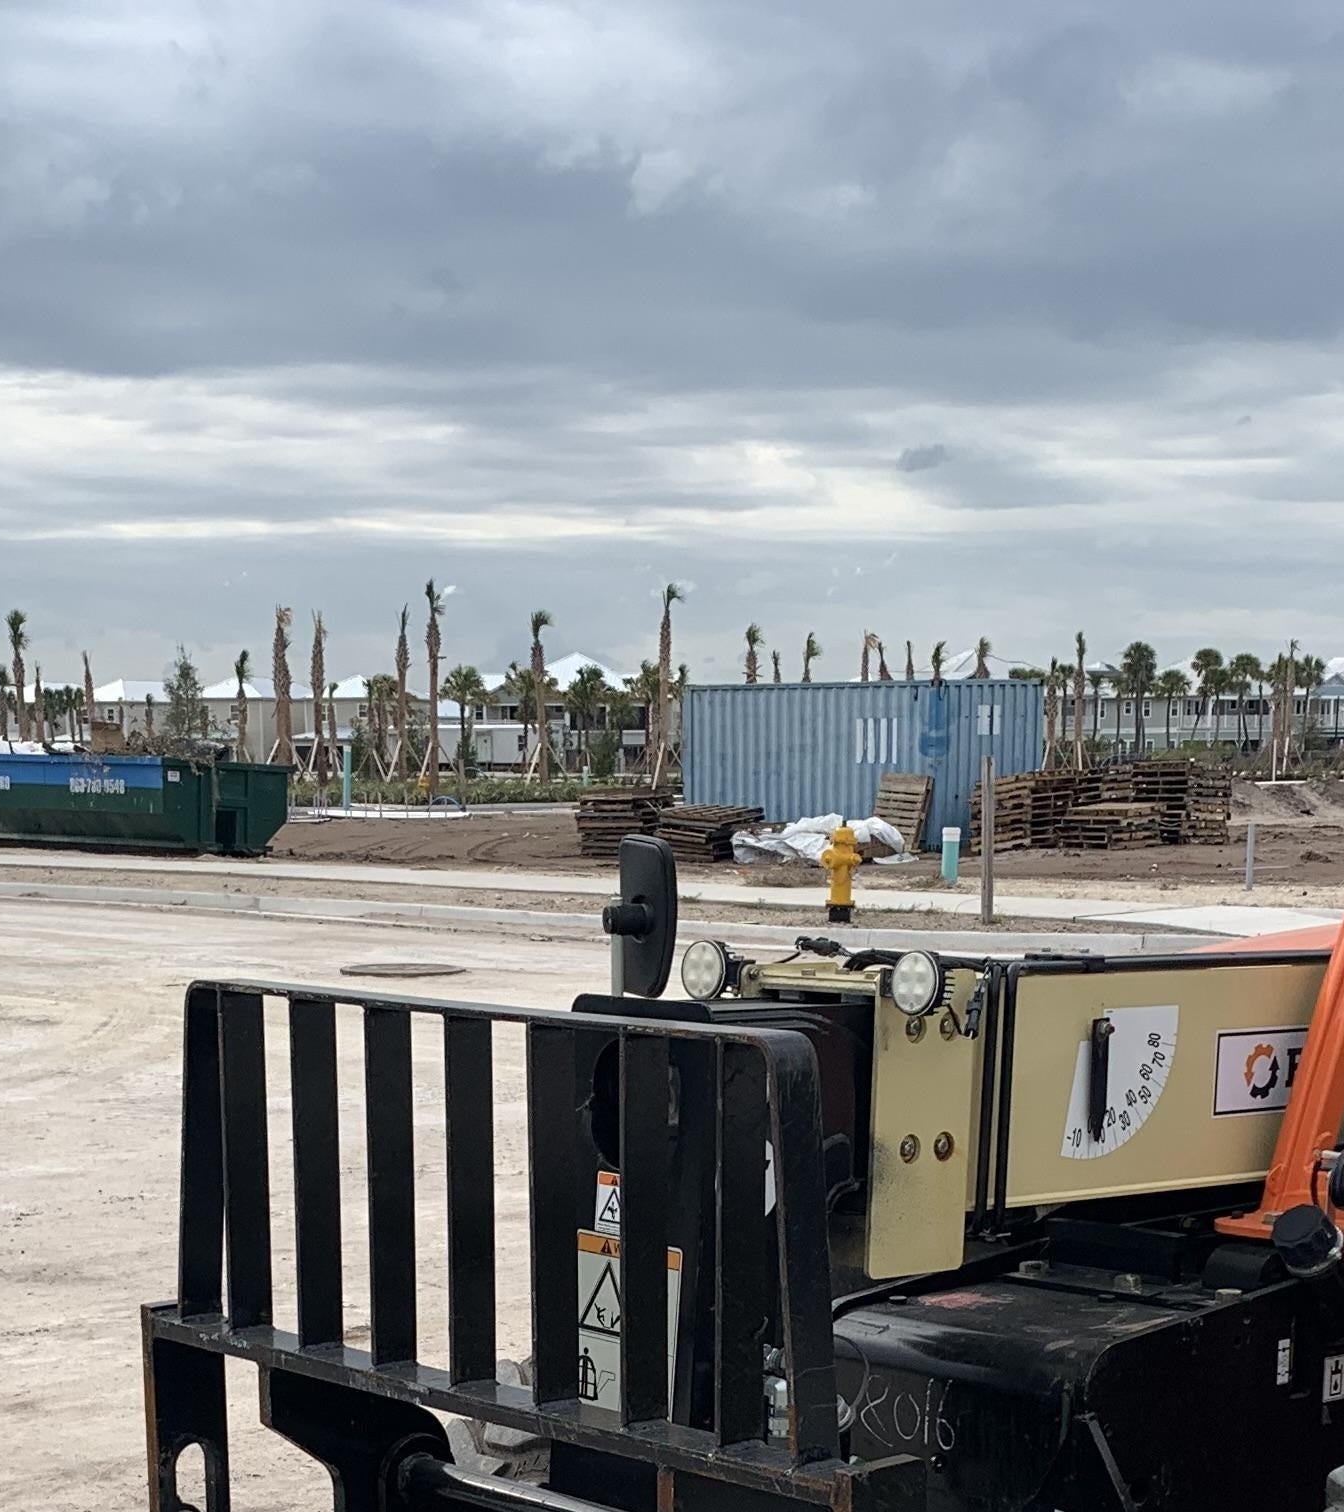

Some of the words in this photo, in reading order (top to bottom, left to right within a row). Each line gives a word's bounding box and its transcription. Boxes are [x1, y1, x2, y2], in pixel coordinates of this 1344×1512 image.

[1147, 1032, 1161, 1048] 80
[1152, 1051, 1165, 1068] 70
[1139, 1063, 1153, 1081] 60
[1125, 1089, 1138, 1107] 40
[1138, 1085, 1152, 1104] 50
[1106, 1106, 1116, 1127] 20
[1118, 1110, 1131, 1131] 30
[1066, 1128, 1082, 1148] -10
